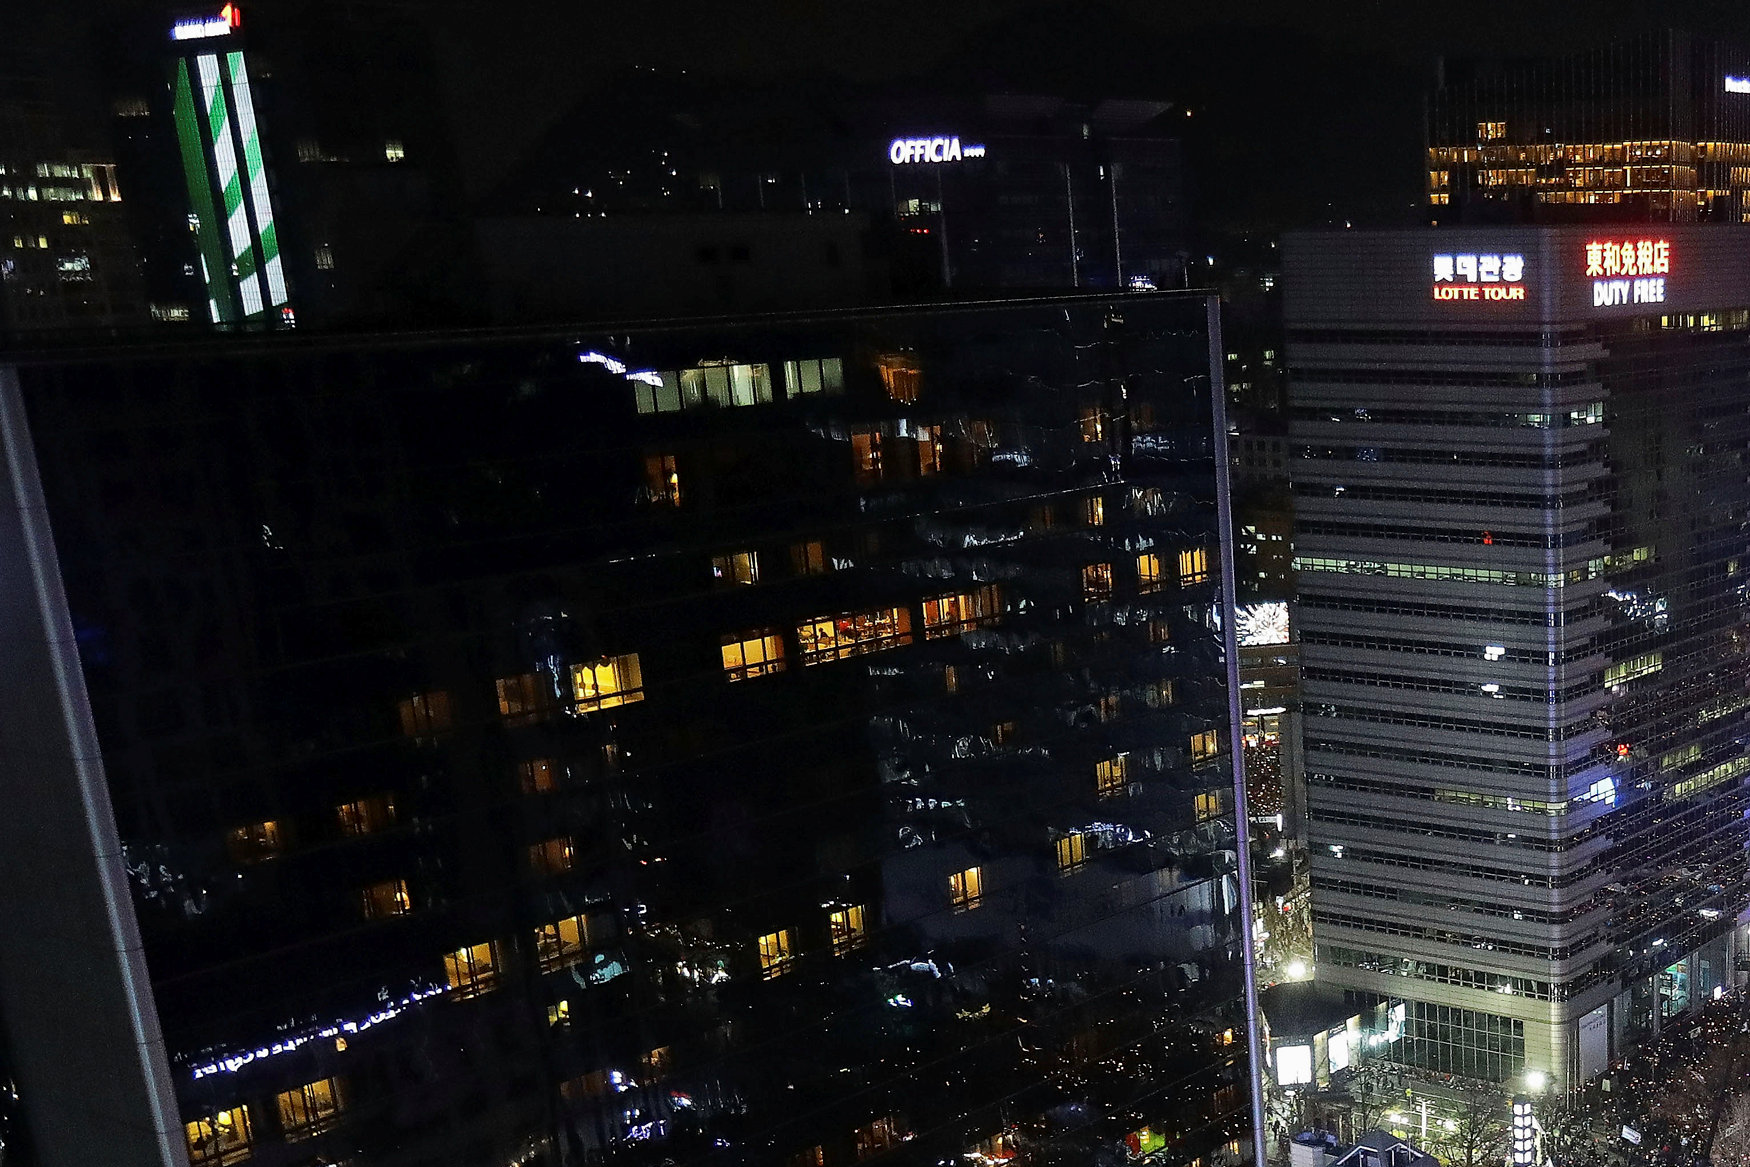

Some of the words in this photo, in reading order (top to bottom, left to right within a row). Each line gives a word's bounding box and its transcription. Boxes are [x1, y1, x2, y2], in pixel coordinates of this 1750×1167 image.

[889, 138, 962, 164] OFFICIA
[1433, 287, 1480, 300] LOTTE
[1483, 287, 1525, 300] TOUR
[1593, 281, 1631, 307] DUTY
[1633, 279, 1665, 304] FREE
